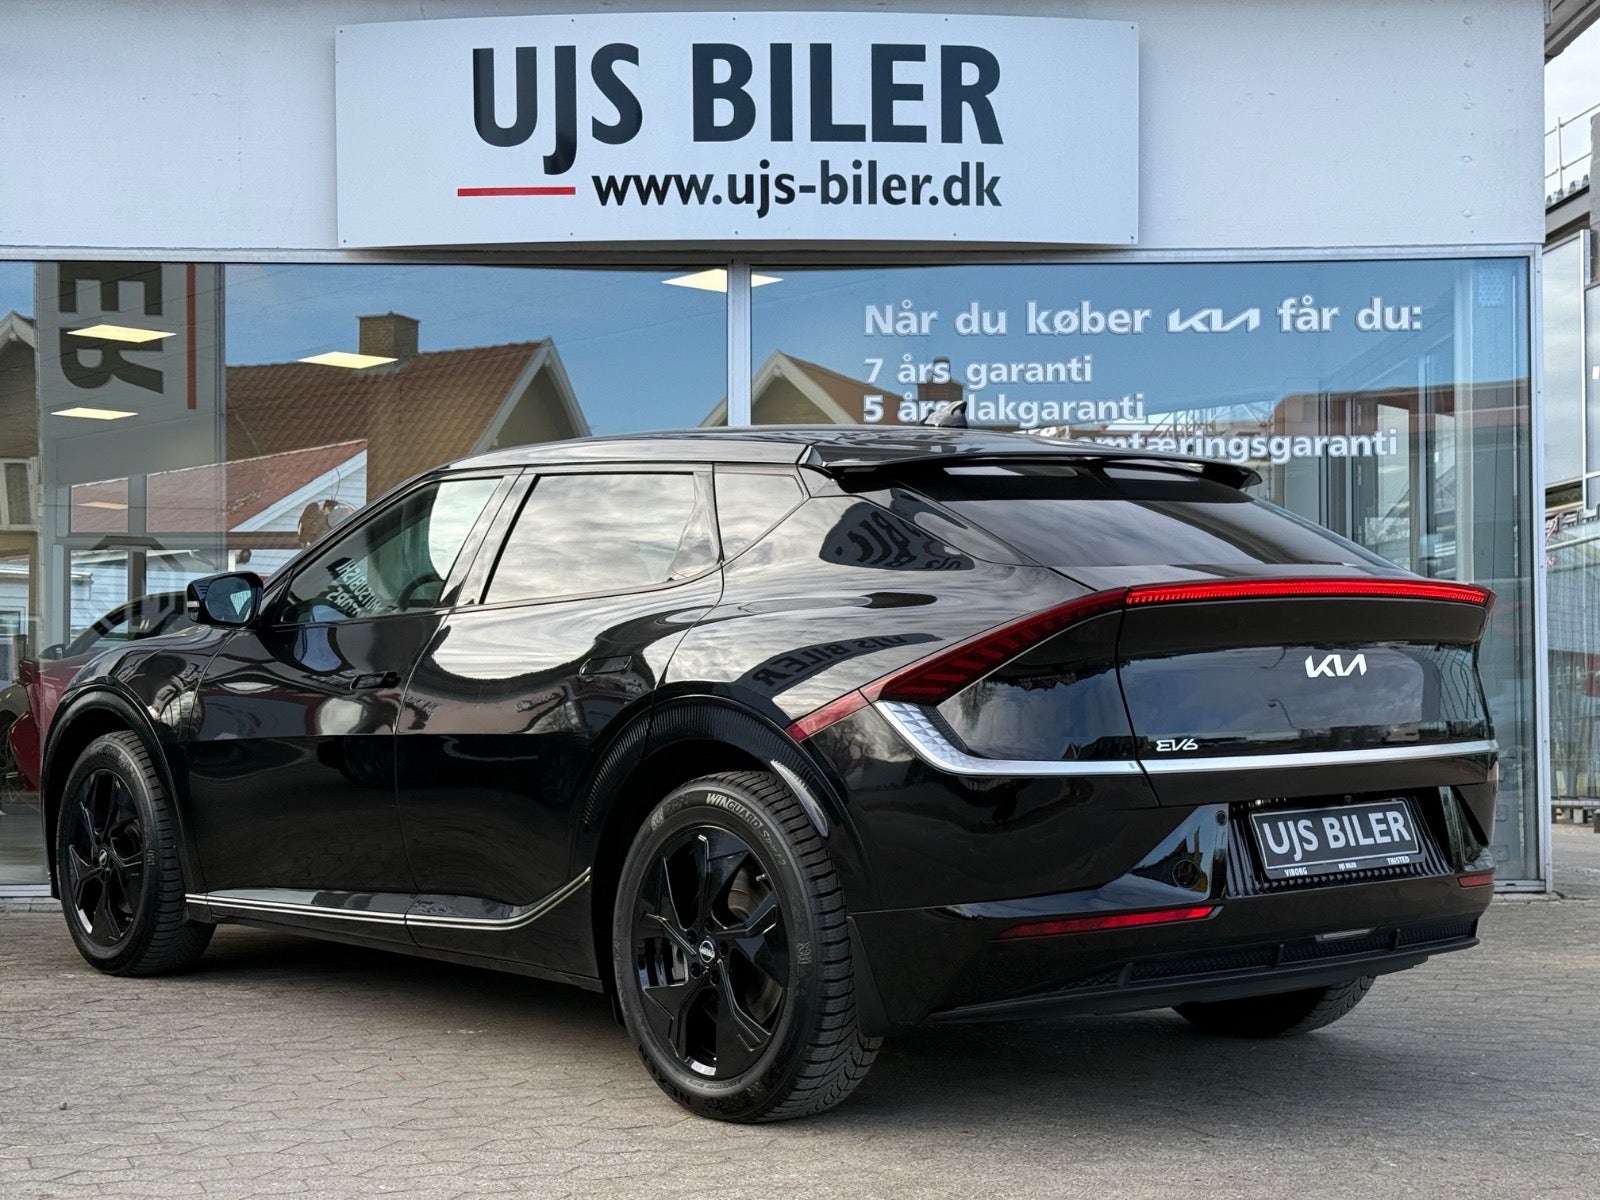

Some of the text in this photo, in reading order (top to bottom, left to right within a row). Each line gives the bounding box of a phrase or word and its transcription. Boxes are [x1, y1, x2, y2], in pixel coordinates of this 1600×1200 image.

[472, 42, 1004, 175] UJS BILER
[591, 158, 1003, 219] www.ujs-biler.dk
[864, 294, 1423, 336] Når du køber KIA får du:
[863, 353, 1092, 390] 7 års garanti
[863, 394, 884, 423] 5
[968, 392, 1144, 429] lakgaranti
[1076, 427, 1398, 464] tæringsgaranti
[1305, 653, 1367, 678] KIA
[1156, 738, 1199, 752] EV6
[705, 792, 764, 830] WINGUARD
[1262, 810, 1412, 862] UJS BILER
[1284, 866, 1308, 877] VIBORG
[1386, 855, 1410, 865] THISTED
